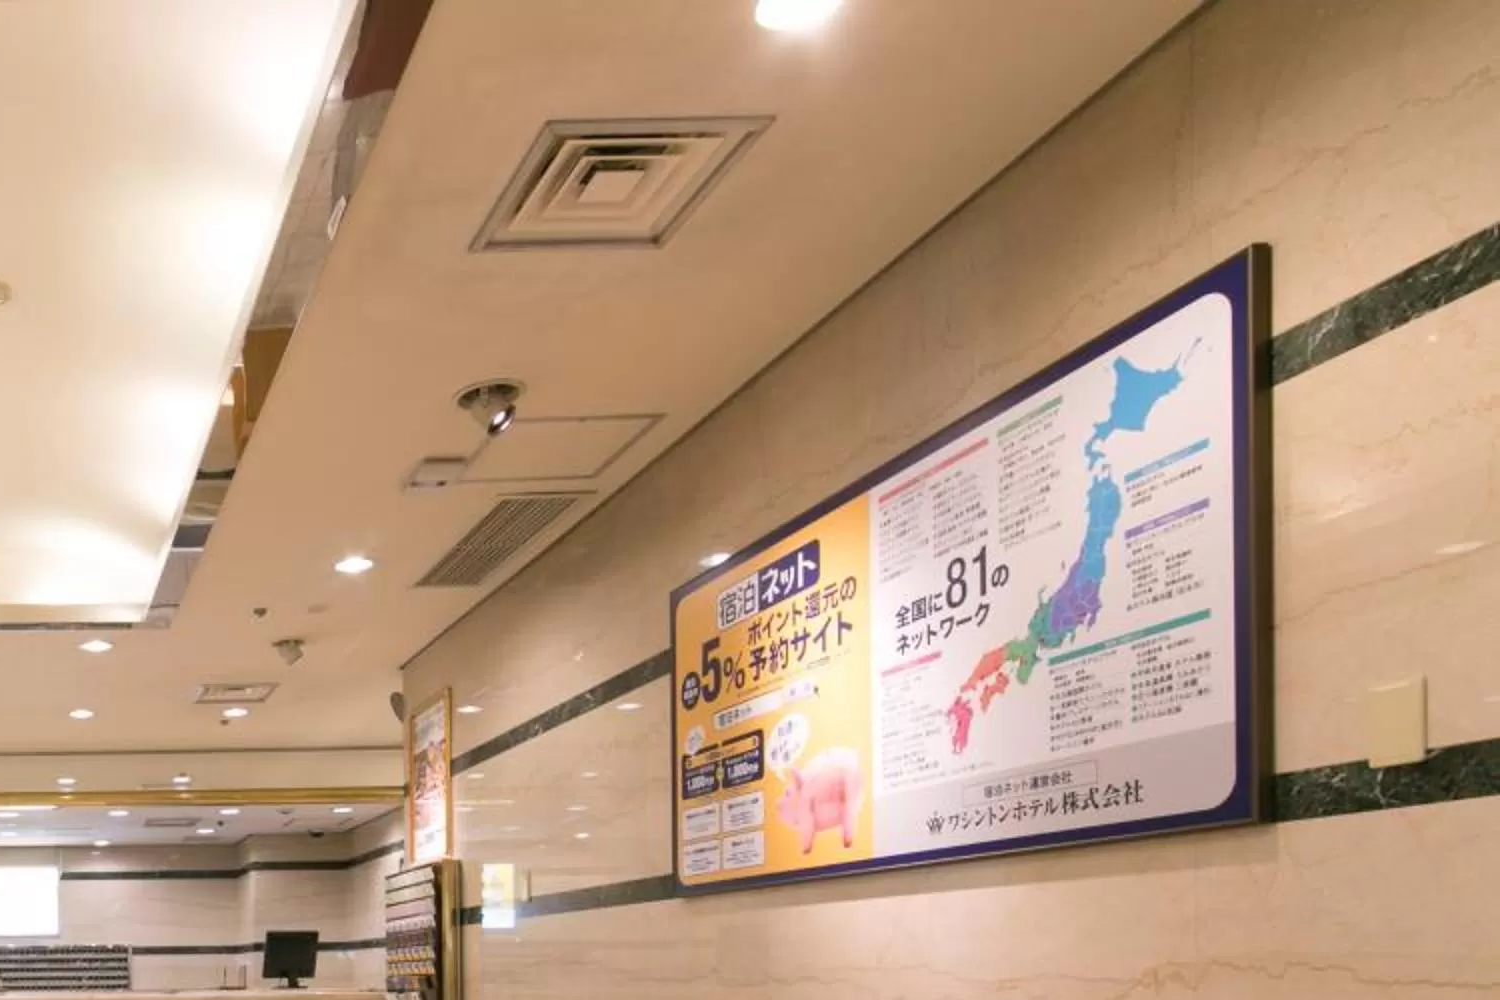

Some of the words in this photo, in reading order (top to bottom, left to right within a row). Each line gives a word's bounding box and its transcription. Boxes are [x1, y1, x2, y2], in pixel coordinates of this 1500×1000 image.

[720, 552, 817, 627] 宿泊ネット
[747, 575, 857, 645] ポイント還元の
[895, 544, 1010, 629] 全国に81の
[701, 636, 746, 703] 5%
[748, 611, 853, 682] 予約サイト
[896, 602, 991, 656] ネットワーク
[947, 779, 1145, 832] ワシントンホテル株式会社
